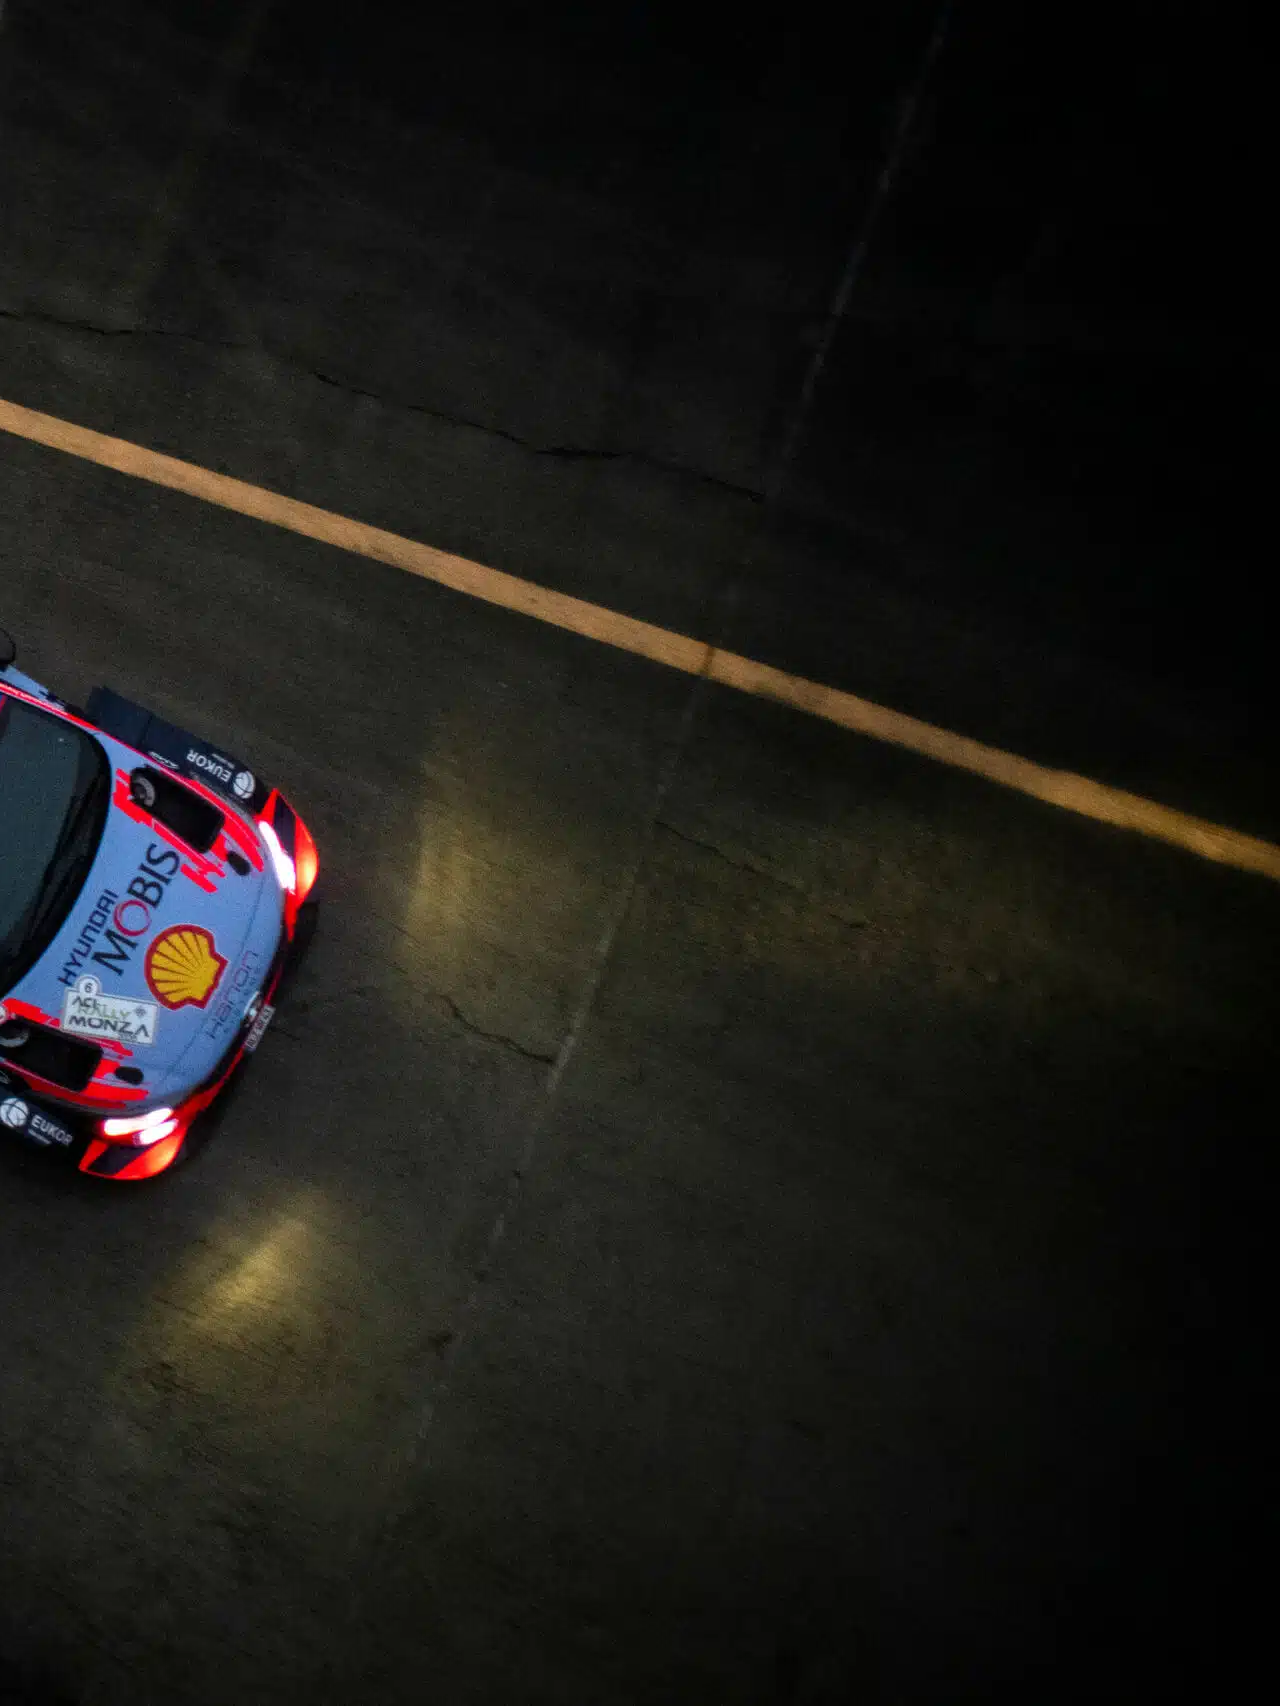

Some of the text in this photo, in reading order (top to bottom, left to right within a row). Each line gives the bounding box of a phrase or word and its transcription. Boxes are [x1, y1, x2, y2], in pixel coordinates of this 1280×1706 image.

[186, 748, 232, 783] EUKOR
[91, 842, 180, 977] MOBIS
[58, 889, 119, 986] HYUNDAI
[84, 983, 93, 993] 6
[69, 1014, 150, 1038] MONZA
[31, 1115, 75, 1147] EUKOR
